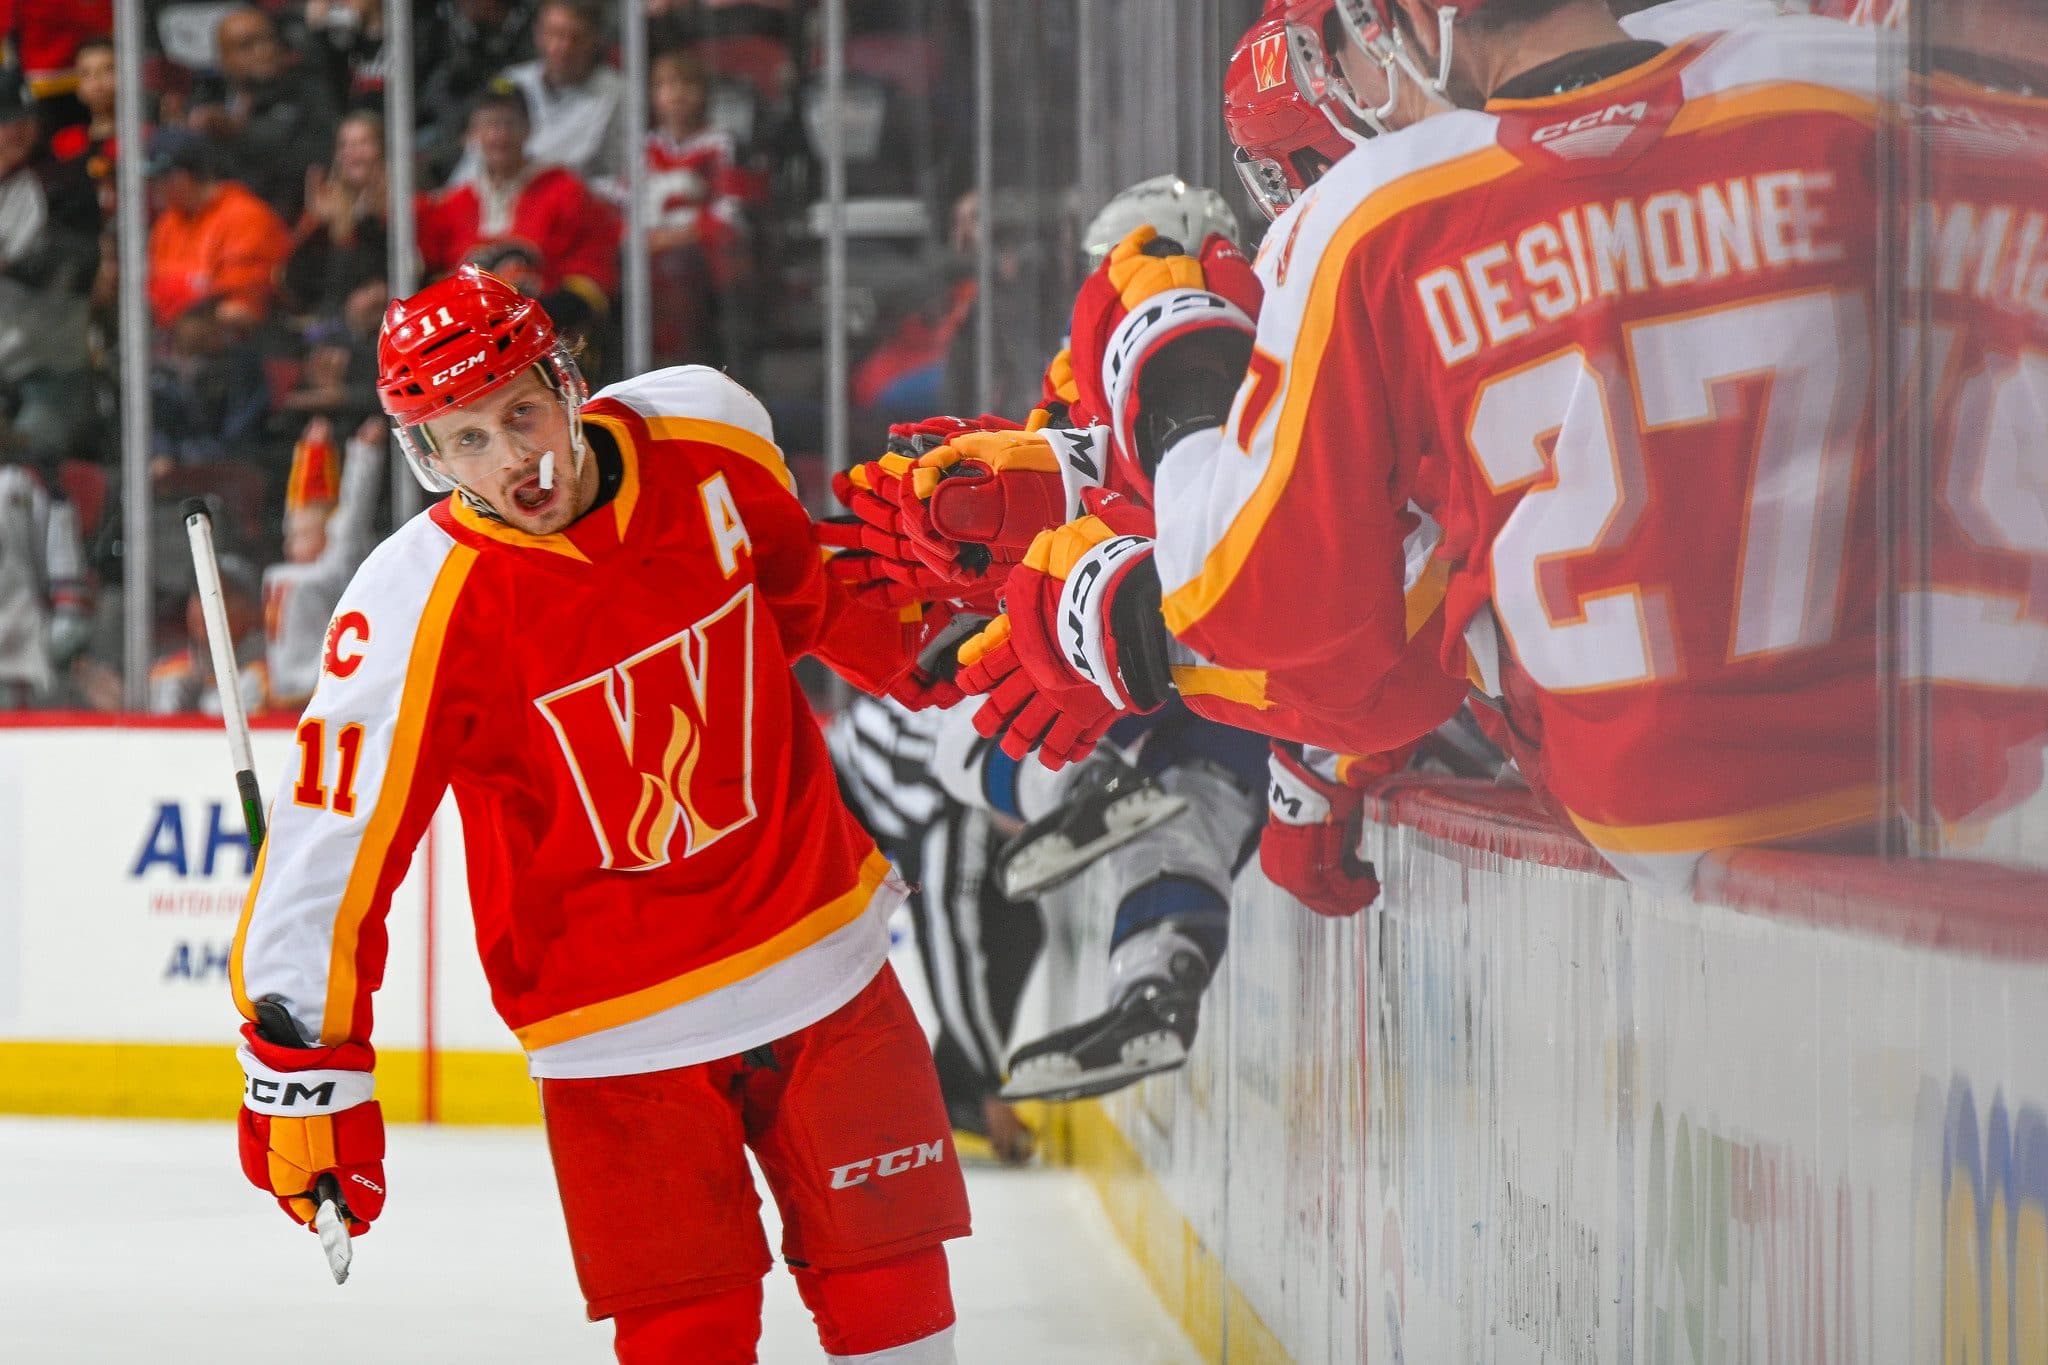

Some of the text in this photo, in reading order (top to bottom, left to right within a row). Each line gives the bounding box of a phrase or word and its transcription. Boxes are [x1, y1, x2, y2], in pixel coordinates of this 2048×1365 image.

[1531, 100, 1648, 143] CCM
[1416, 171, 1838, 367] DESIMONE
[419, 306, 454, 337] 11
[431, 350, 486, 386] CCM
[1466, 286, 1872, 695] 27
[698, 470, 753, 580] A
[533, 583, 757, 872] W
[294, 717, 365, 817] 11
[244, 1072, 337, 1106] CM
[351, 1174, 384, 1195] CCM
[828, 1139, 943, 1190] CCM
